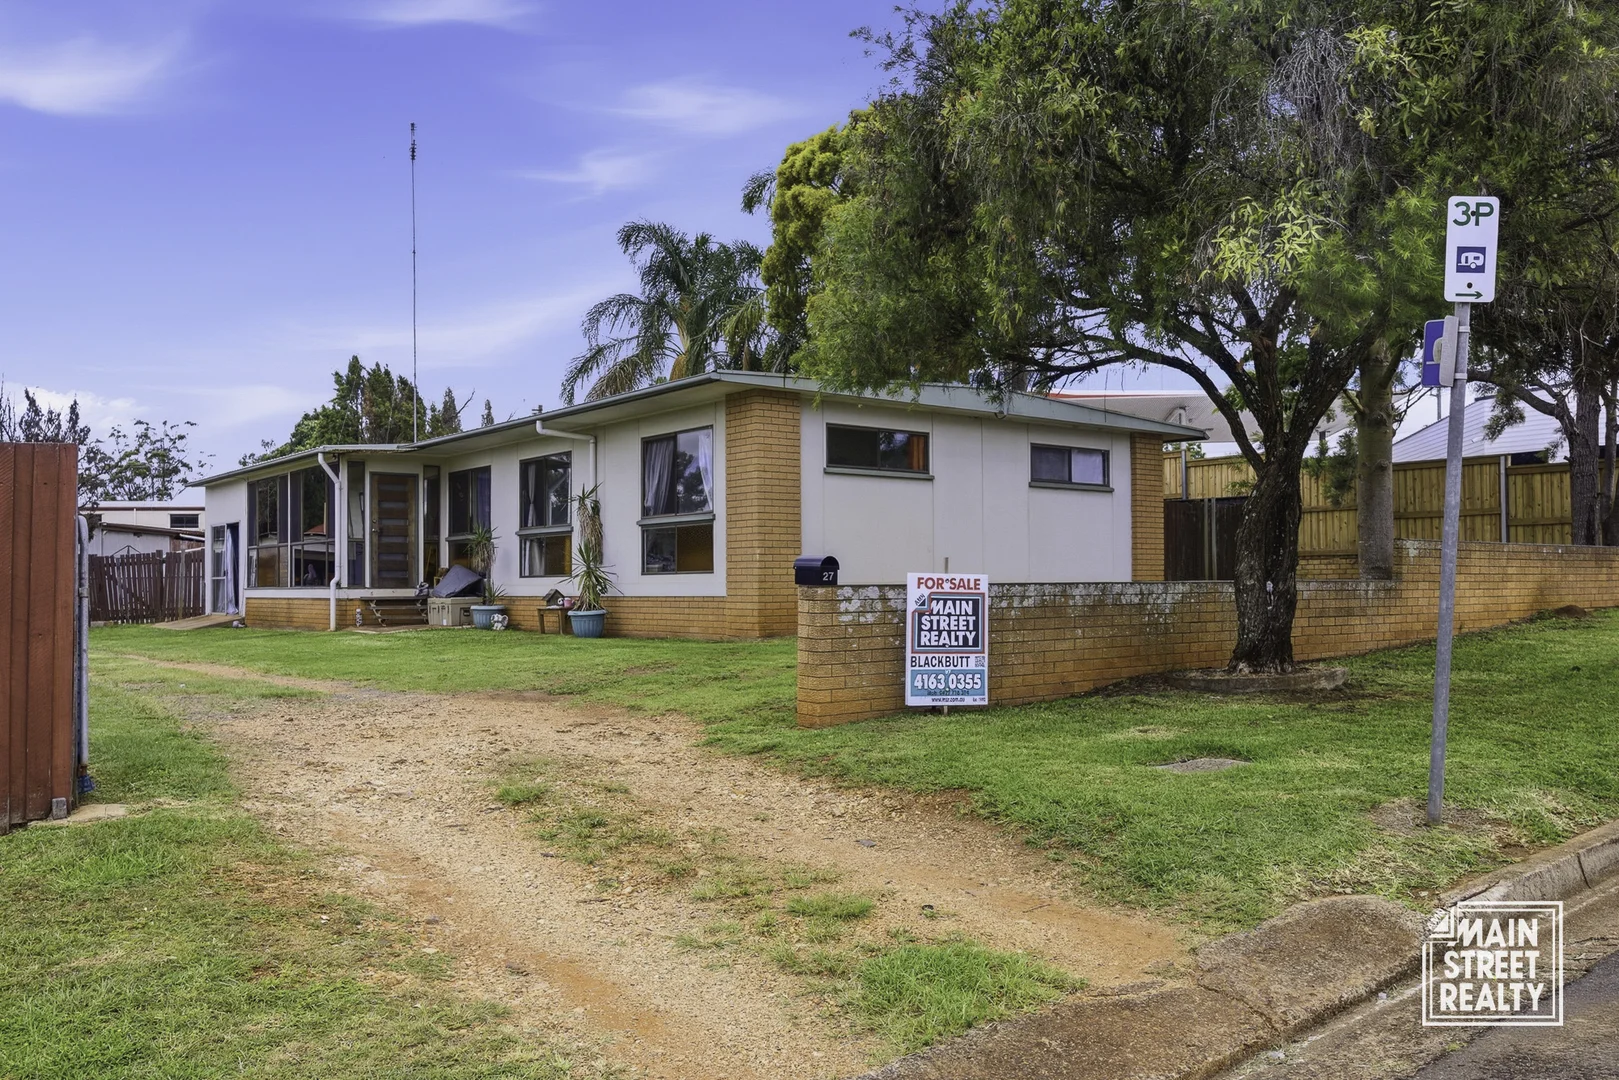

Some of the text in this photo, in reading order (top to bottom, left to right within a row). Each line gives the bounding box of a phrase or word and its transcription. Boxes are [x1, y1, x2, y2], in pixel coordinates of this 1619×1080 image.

[1453, 201, 1495, 226] 3P
[823, 571, 834, 581] 27
[917, 577, 981, 590] FOR SALE
[925, 600, 973, 615] MAIN
[921, 615, 976, 631] STREET
[920, 631, 976, 646] REALTY
[910, 655, 971, 668] BLACKBUTT
[914, 673, 982, 690] 4163 0355
